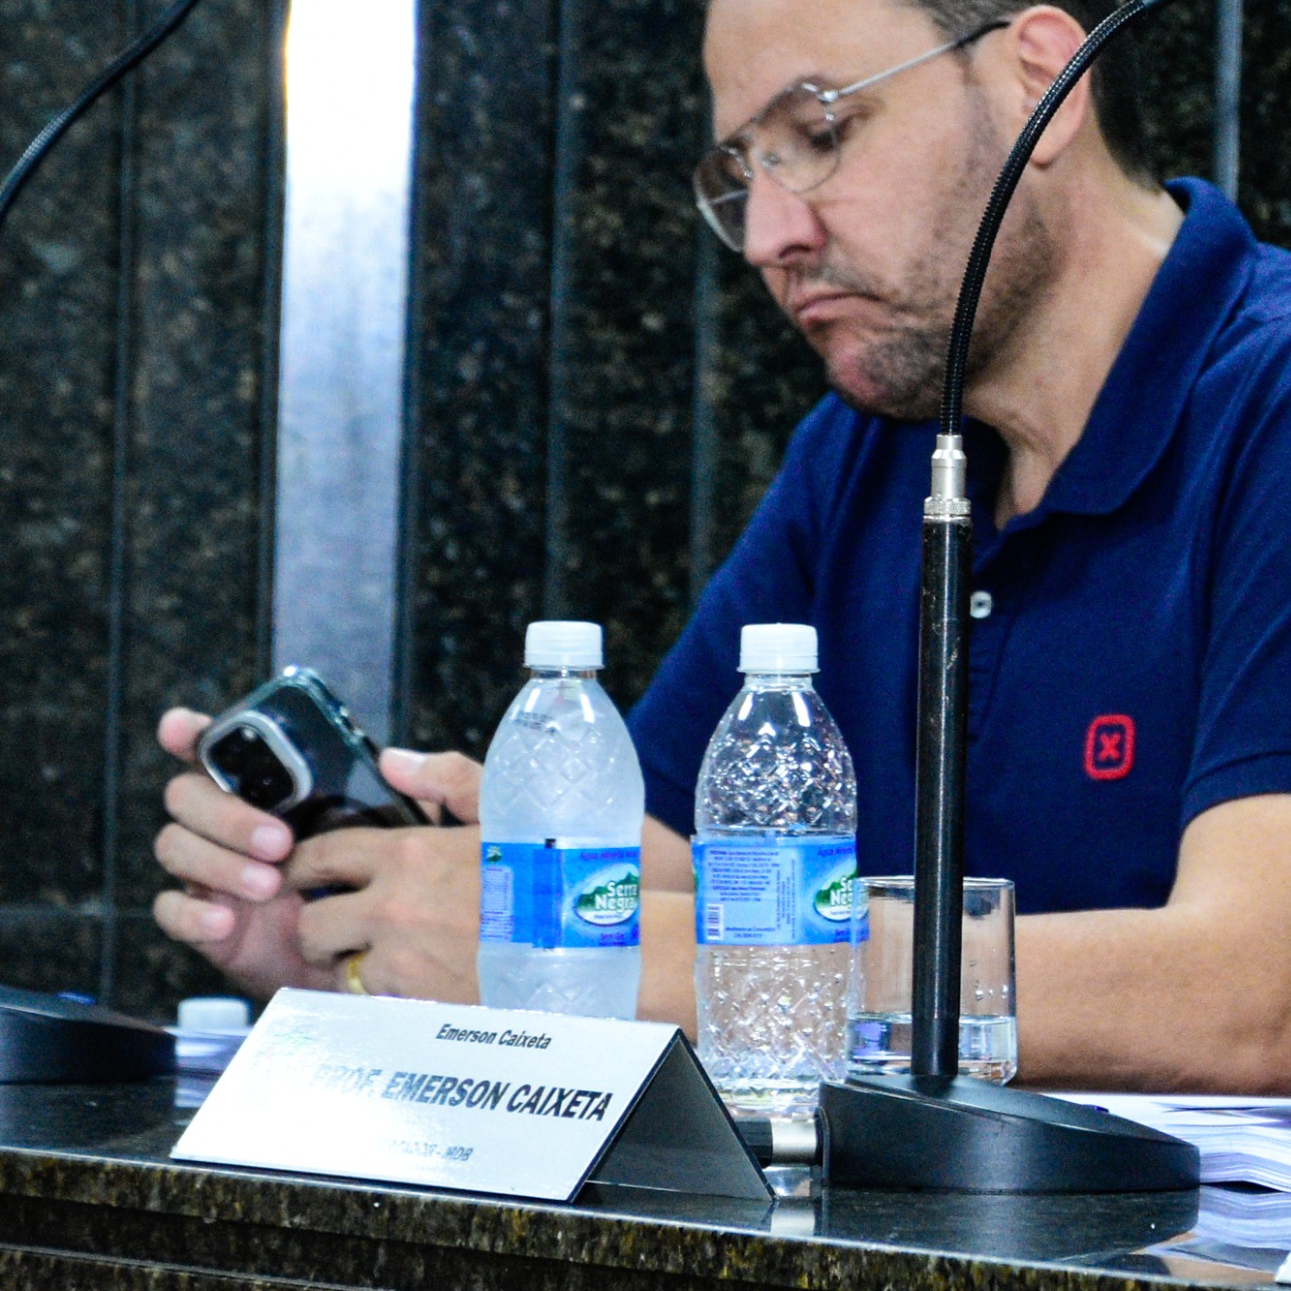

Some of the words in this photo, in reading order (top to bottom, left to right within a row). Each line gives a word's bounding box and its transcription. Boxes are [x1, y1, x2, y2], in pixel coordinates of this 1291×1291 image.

[435, 1023, 498, 1045] Emerson
[498, 1029, 552, 1050] Caixeta
[382, 1070, 509, 1111] EMERSON
[506, 1083, 614, 1122] CAIXETA
